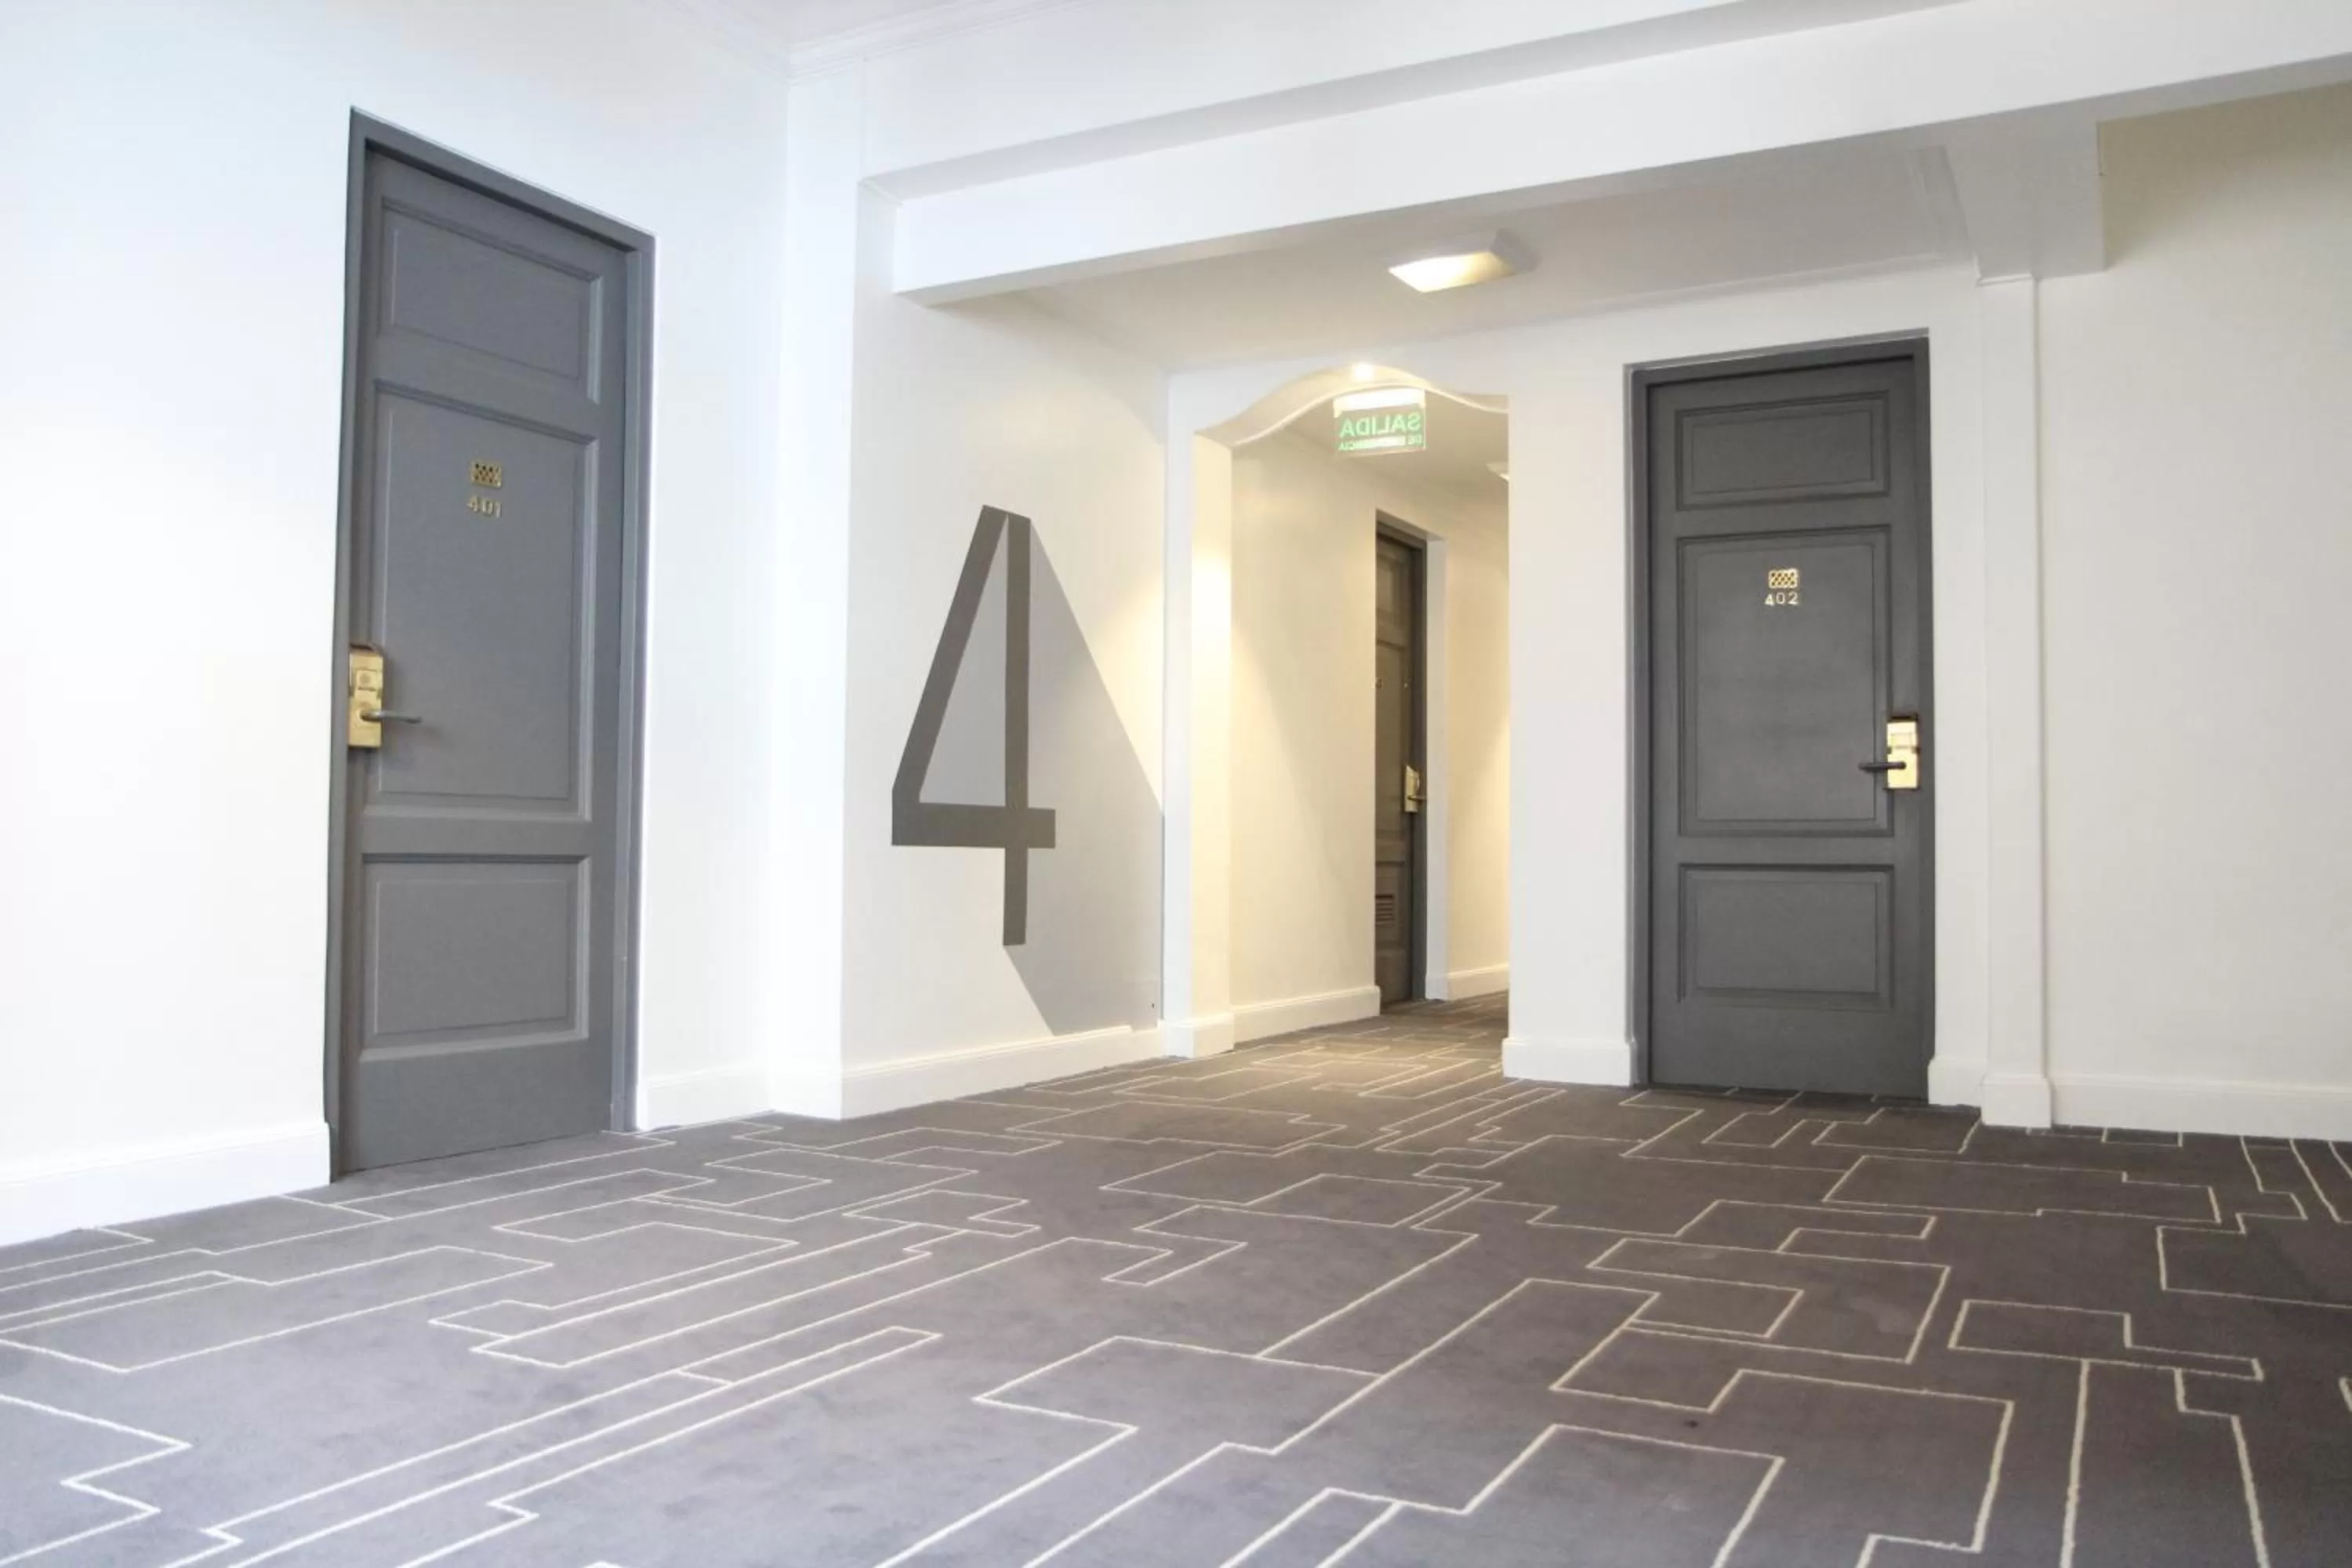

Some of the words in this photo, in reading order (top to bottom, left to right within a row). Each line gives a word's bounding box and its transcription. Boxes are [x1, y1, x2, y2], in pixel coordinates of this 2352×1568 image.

[466, 495, 503, 518] 401
[1764, 591, 1798, 606] 402
[891, 504, 1056, 946] 4
